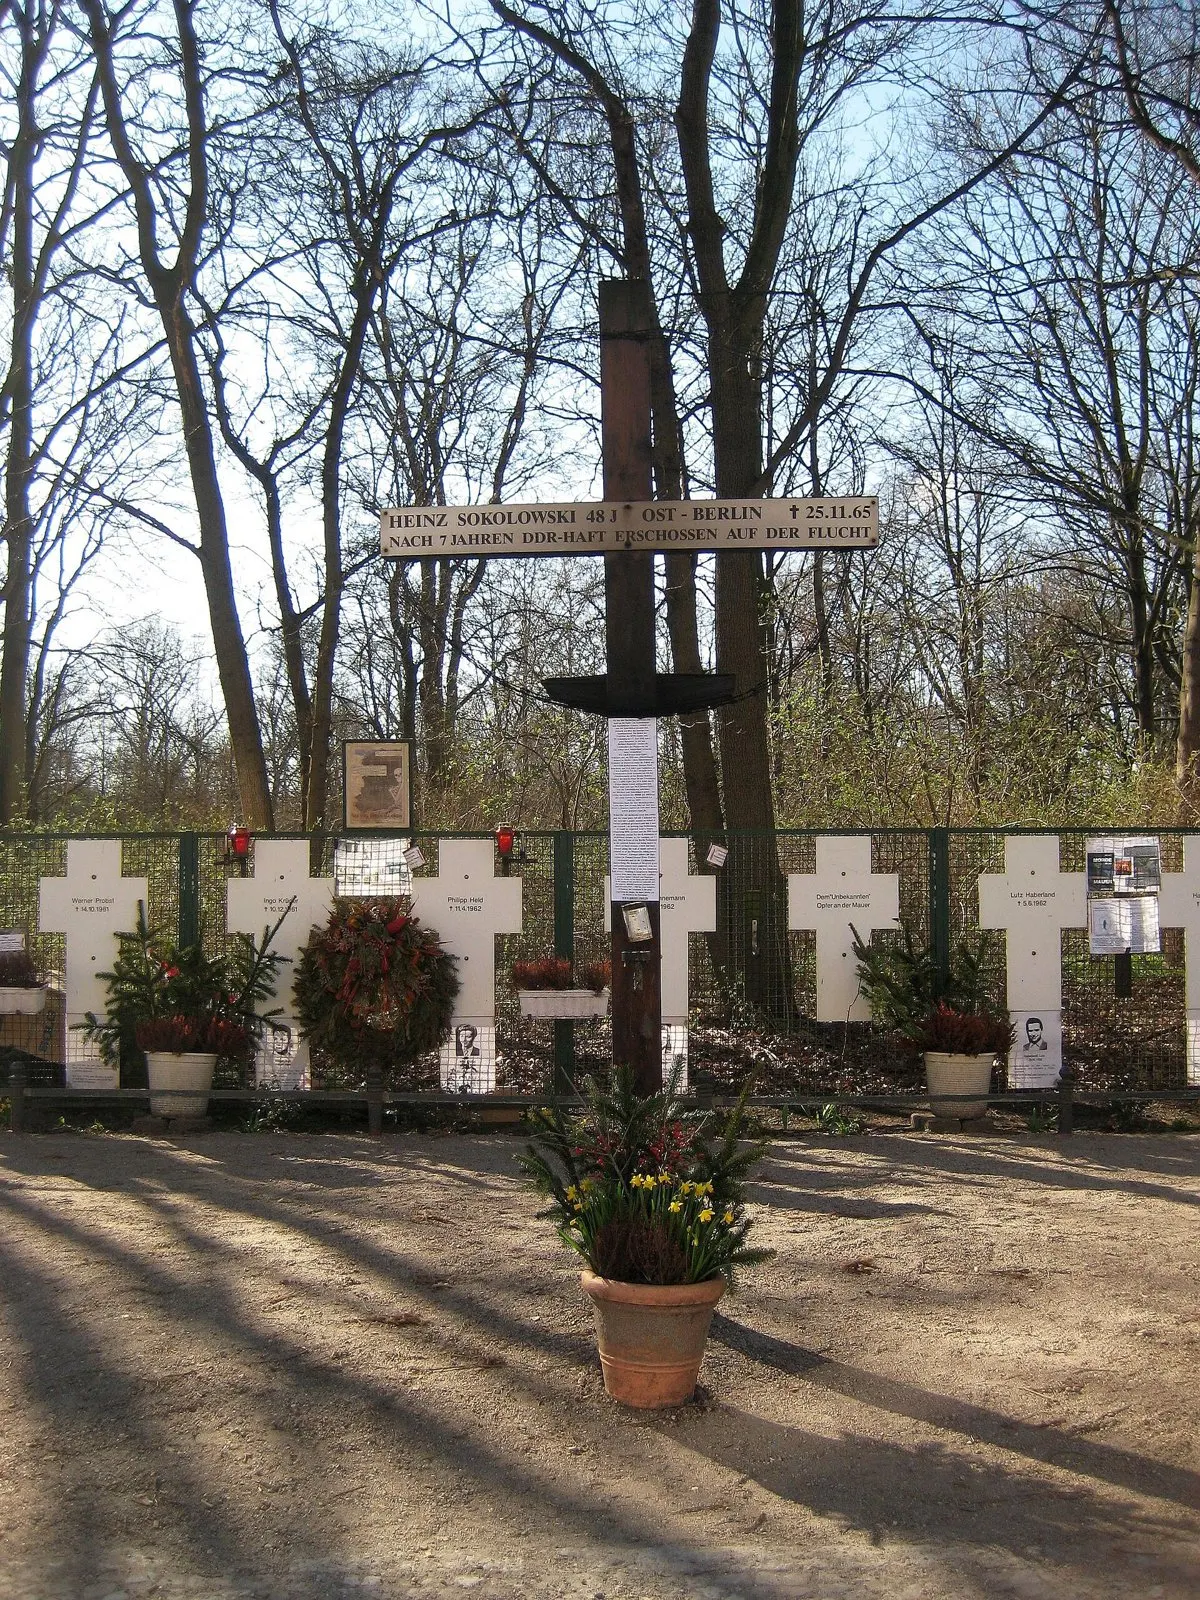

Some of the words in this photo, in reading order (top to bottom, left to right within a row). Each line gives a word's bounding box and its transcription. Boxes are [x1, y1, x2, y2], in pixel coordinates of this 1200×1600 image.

[389, 513, 449, 529] HEINZ
[457, 510, 577, 528] SOKOLOWSKI
[586, 509, 605, 524] 48
[642, 507, 677, 522] OST
[692, 506, 763, 521] BERLIN
[805, 505, 872, 519] 25.11.65
[389, 535, 433, 548] NACH
[439, 535, 447, 547] 7
[450, 532, 514, 546] JAHREN
[523, 530, 607, 545] DDR-HAFT
[615, 528, 718, 542] ERSCHOSSEN
[726, 527, 758, 540] AUF
[766, 527, 800, 539] DER
[808, 526, 872, 539] FLUCHT
[263, 897, 277, 905] Ingo
[447, 896, 468, 904] Philipp
